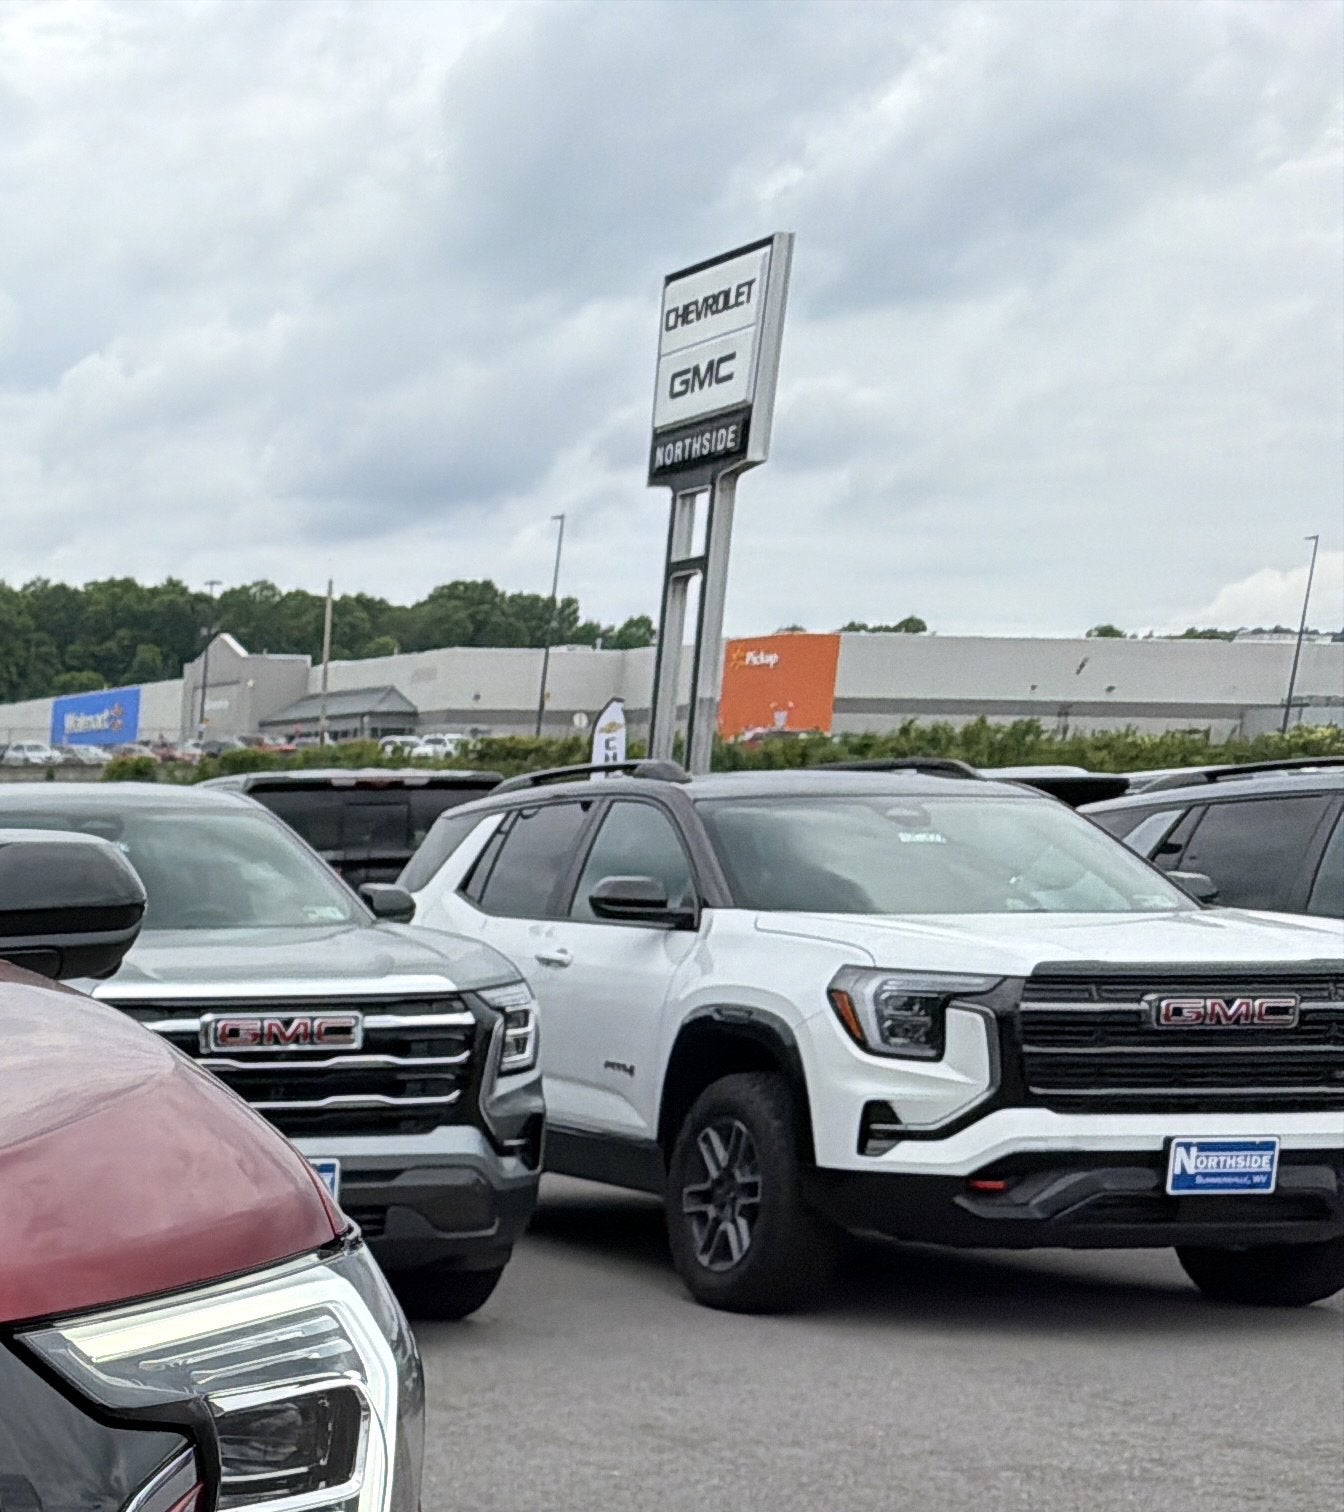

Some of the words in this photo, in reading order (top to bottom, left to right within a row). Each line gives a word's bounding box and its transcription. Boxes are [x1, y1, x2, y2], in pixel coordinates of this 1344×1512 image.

[665, 278, 756, 331] CHEVROLET
[669, 351, 736, 399] GMC
[655, 425, 737, 466] NORTHSIDE
[745, 650, 779, 668] Pickup
[1161, 998, 1295, 1024] GMC
[217, 1018, 356, 1045] GMC
[1174, 1146, 1271, 1175] NORTHSIDE
